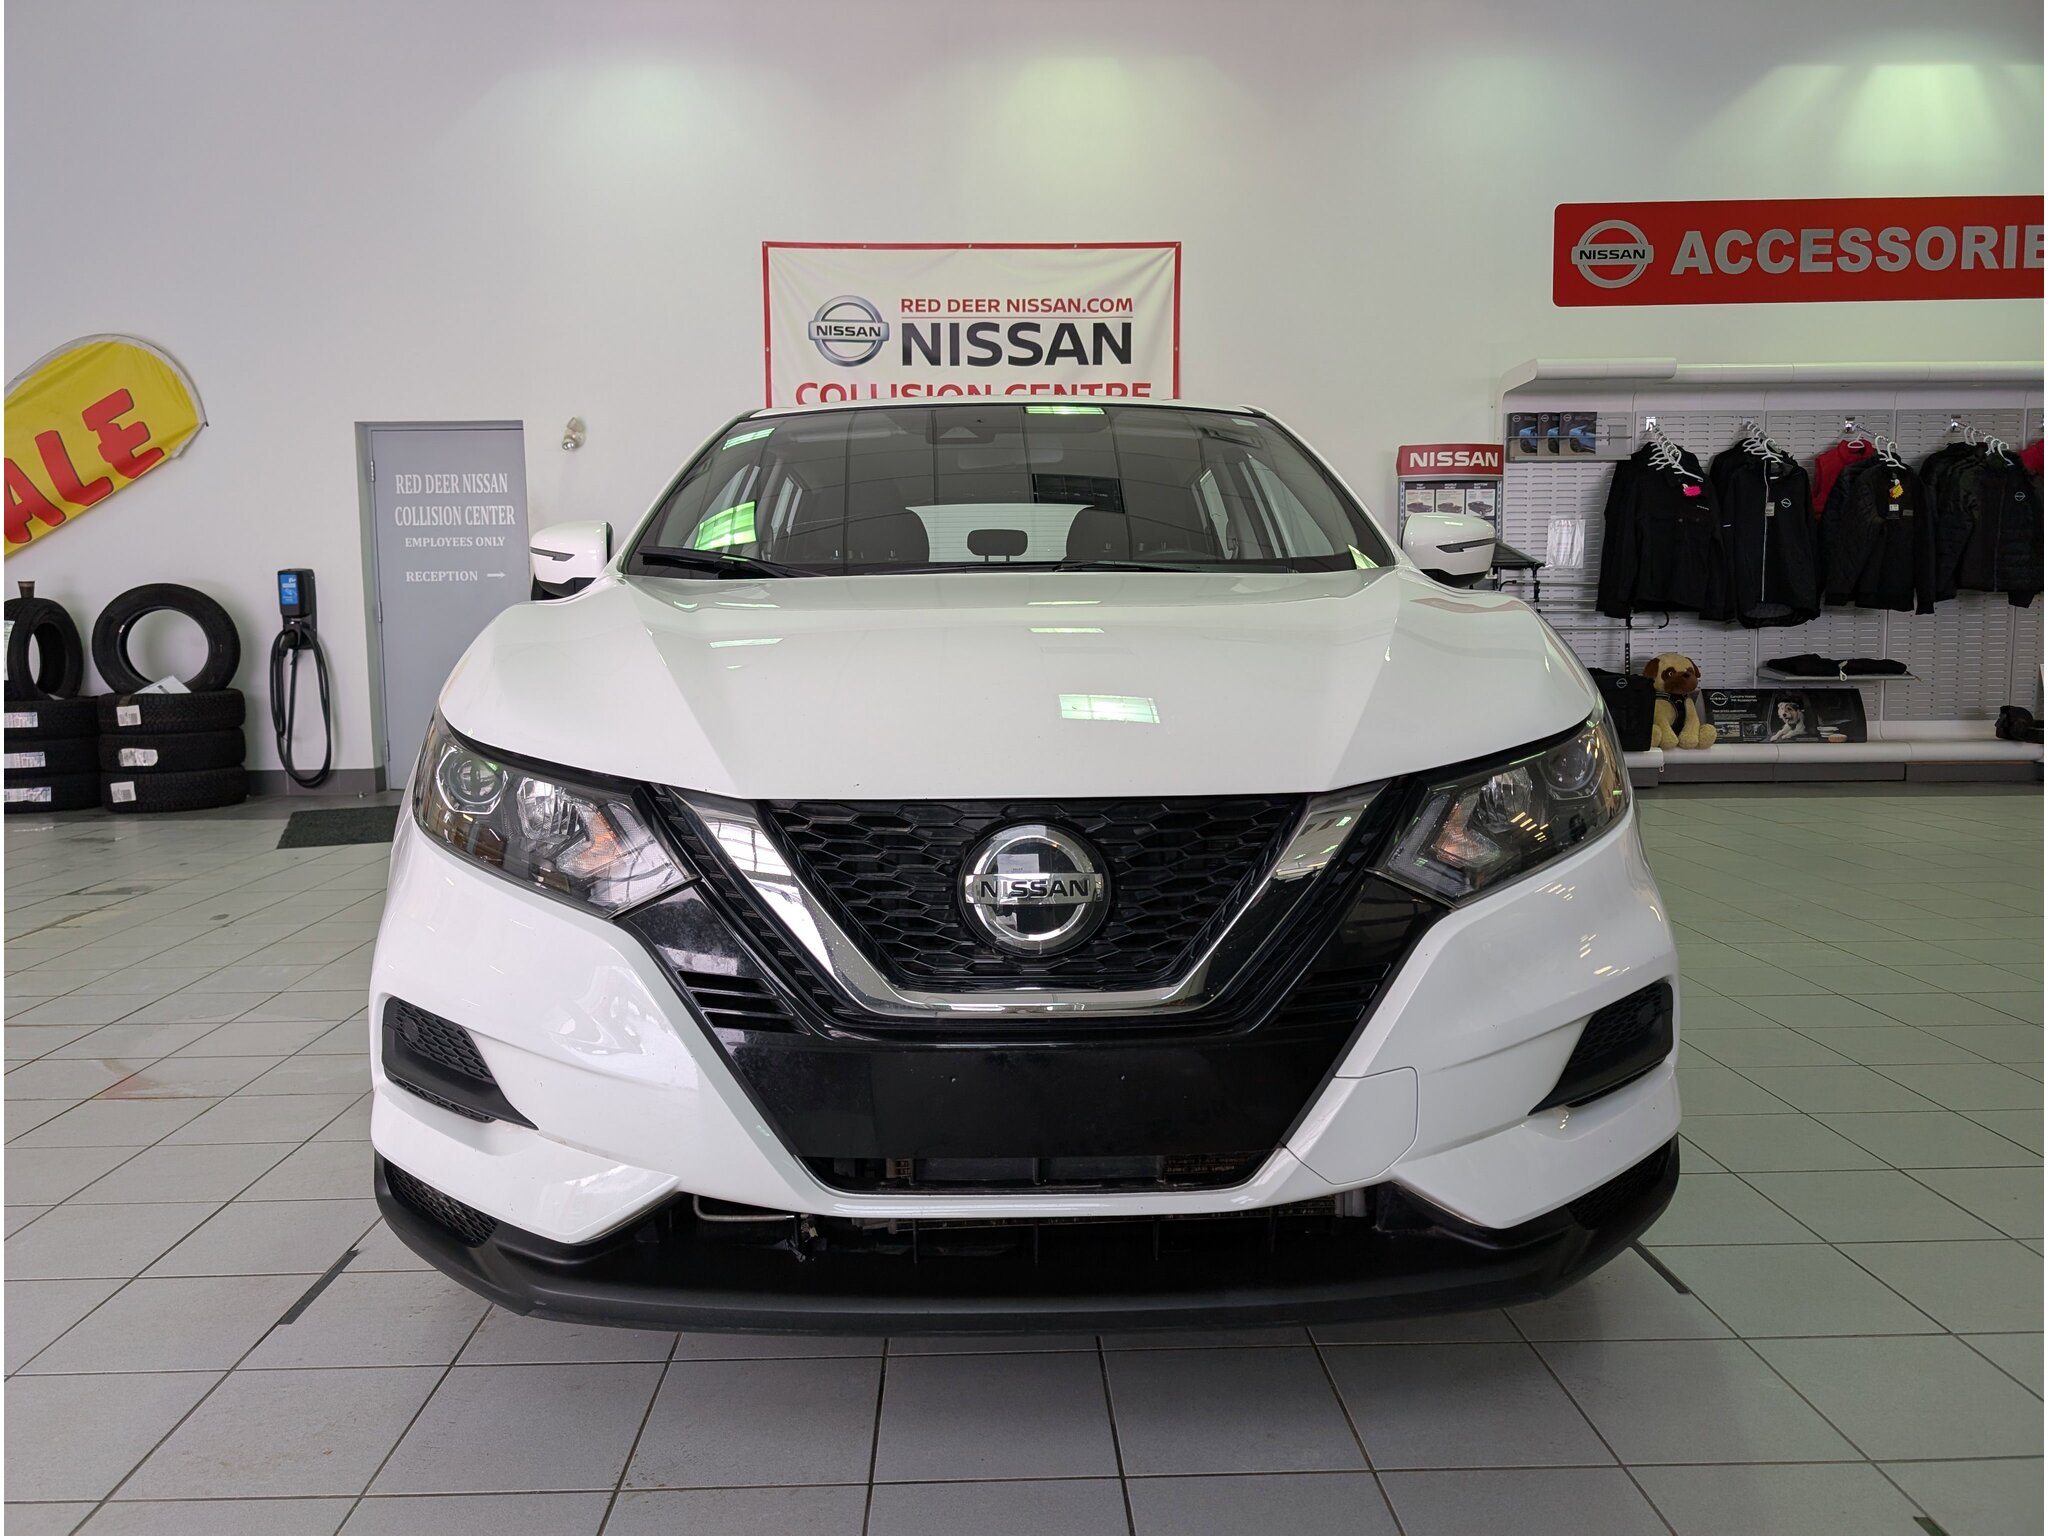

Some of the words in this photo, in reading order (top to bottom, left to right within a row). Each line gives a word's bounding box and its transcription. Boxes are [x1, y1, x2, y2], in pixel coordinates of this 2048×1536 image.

[1580, 249, 1646, 260] NISSAN
[900, 298, 942, 313] RED
[946, 298, 1000, 313] DEER
[1007, 297, 1134, 314] NISSAN.COM
[816, 324, 882, 339] NISSAN
[901, 321, 1133, 367] NISSAN
[1409, 451, 1498, 468] NISSAN
[395, 474, 422, 494] RED
[425, 474, 460, 494] DEER
[463, 473, 508, 494] NISSAN
[395, 506, 462, 526] COLLISION
[465, 505, 516, 526] CENTER
[405, 537, 473, 548] EMPLOYEES
[475, 536, 505, 547] ONLY
[406, 571, 478, 582] RECEPTION
[980, 879, 1090, 898] NISSAN
